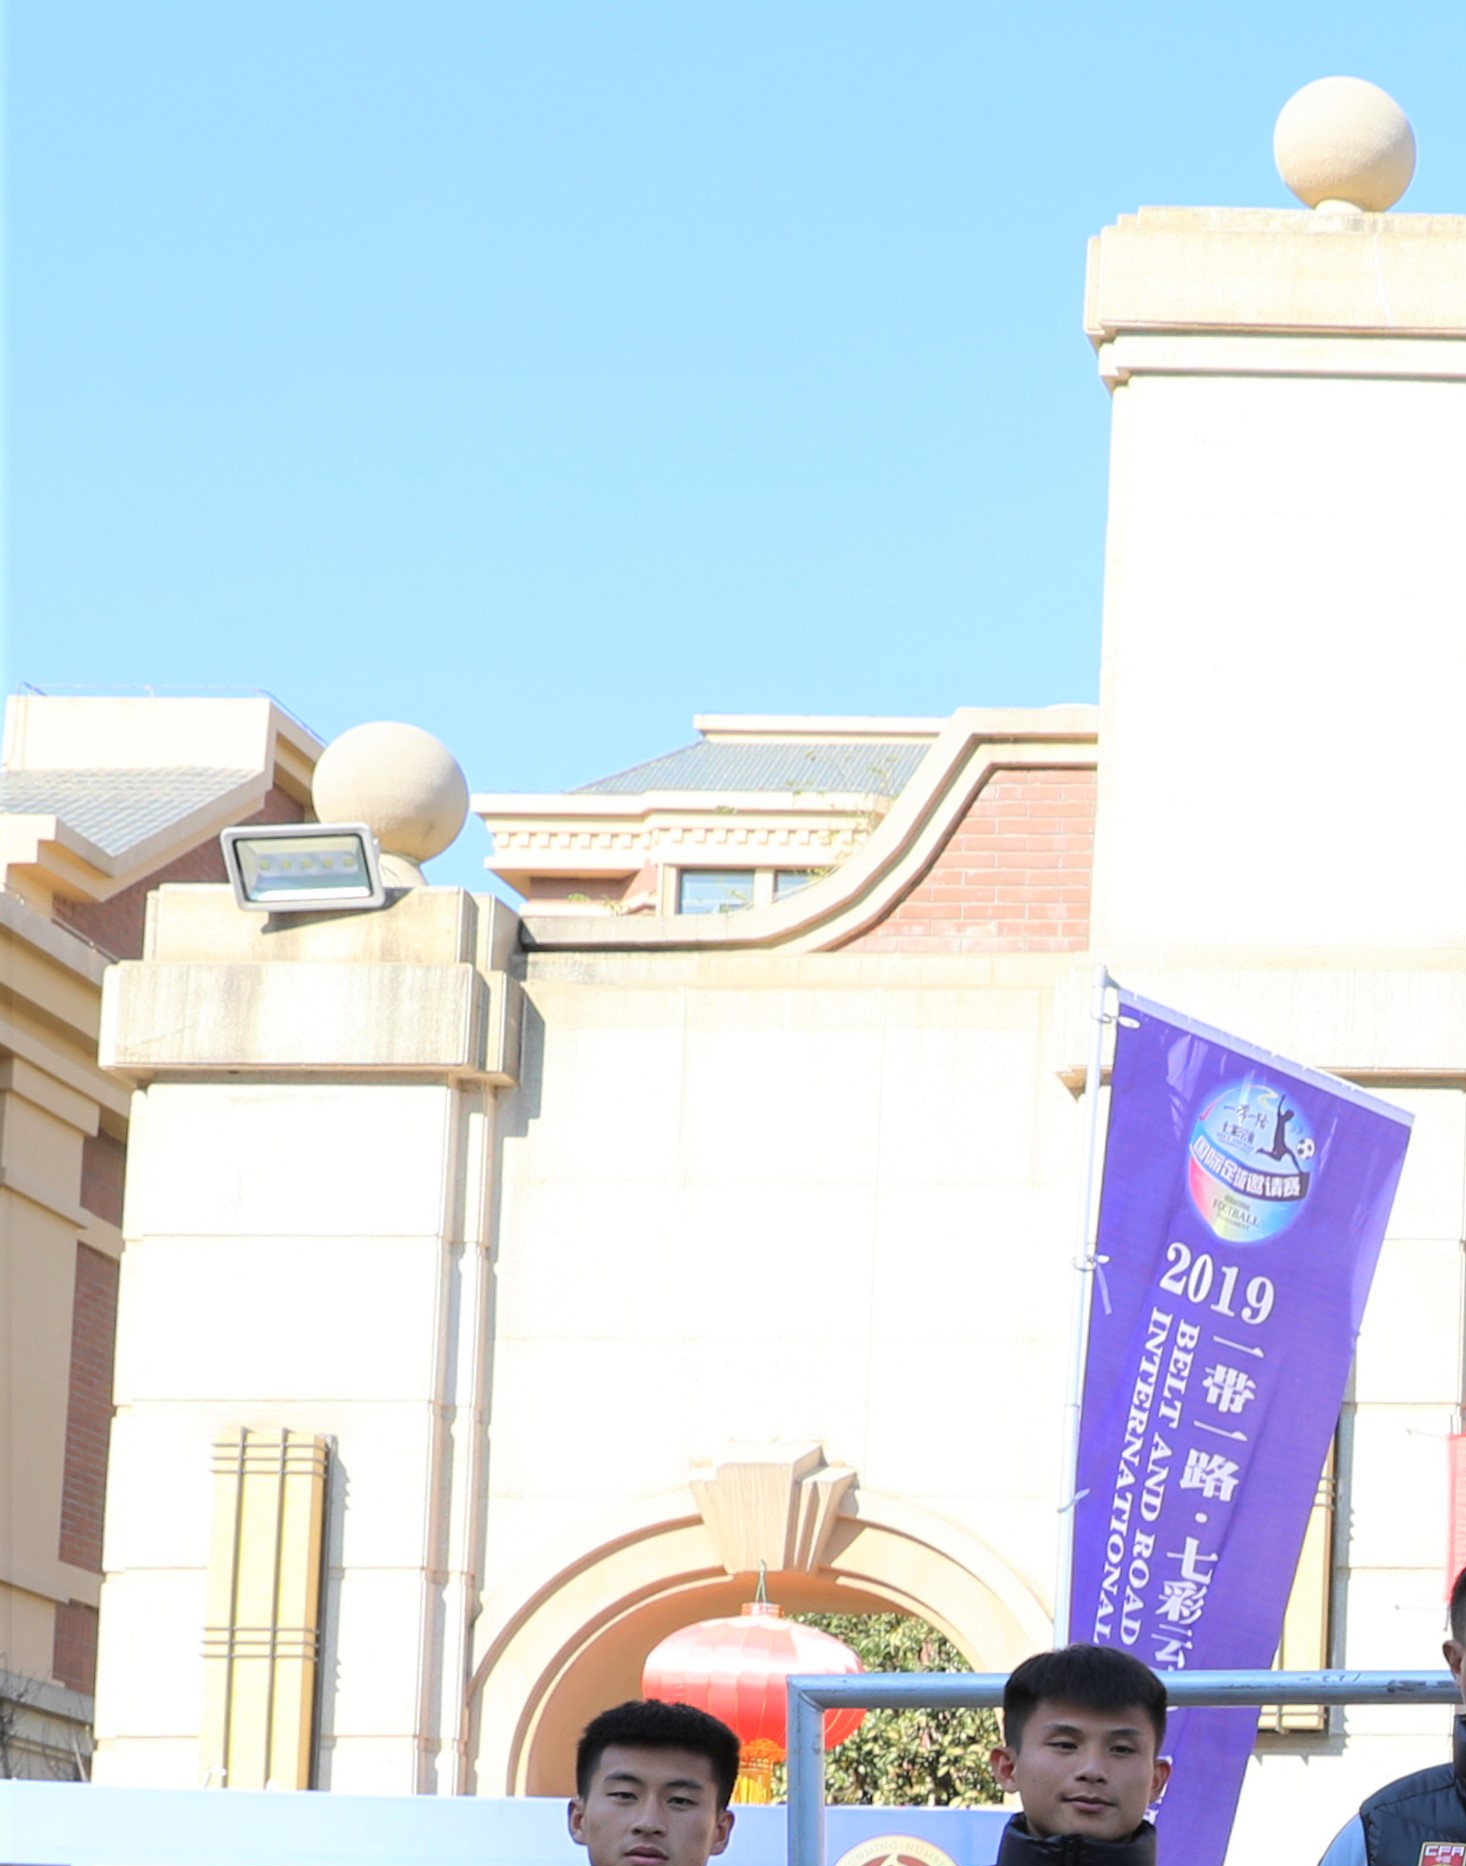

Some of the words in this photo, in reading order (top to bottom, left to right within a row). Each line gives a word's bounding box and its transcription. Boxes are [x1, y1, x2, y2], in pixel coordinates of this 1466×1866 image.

[1158, 1242, 1275, 1325] 2019
[1158, 1318, 1201, 1430] BELT
[1093, 1306, 1174, 1645] INTERNATIONAL
[1140, 1431, 1174, 1523] AND
[1119, 1528, 1157, 1646] ROAD
[1425, 1845, 1465, 1857] CFA
